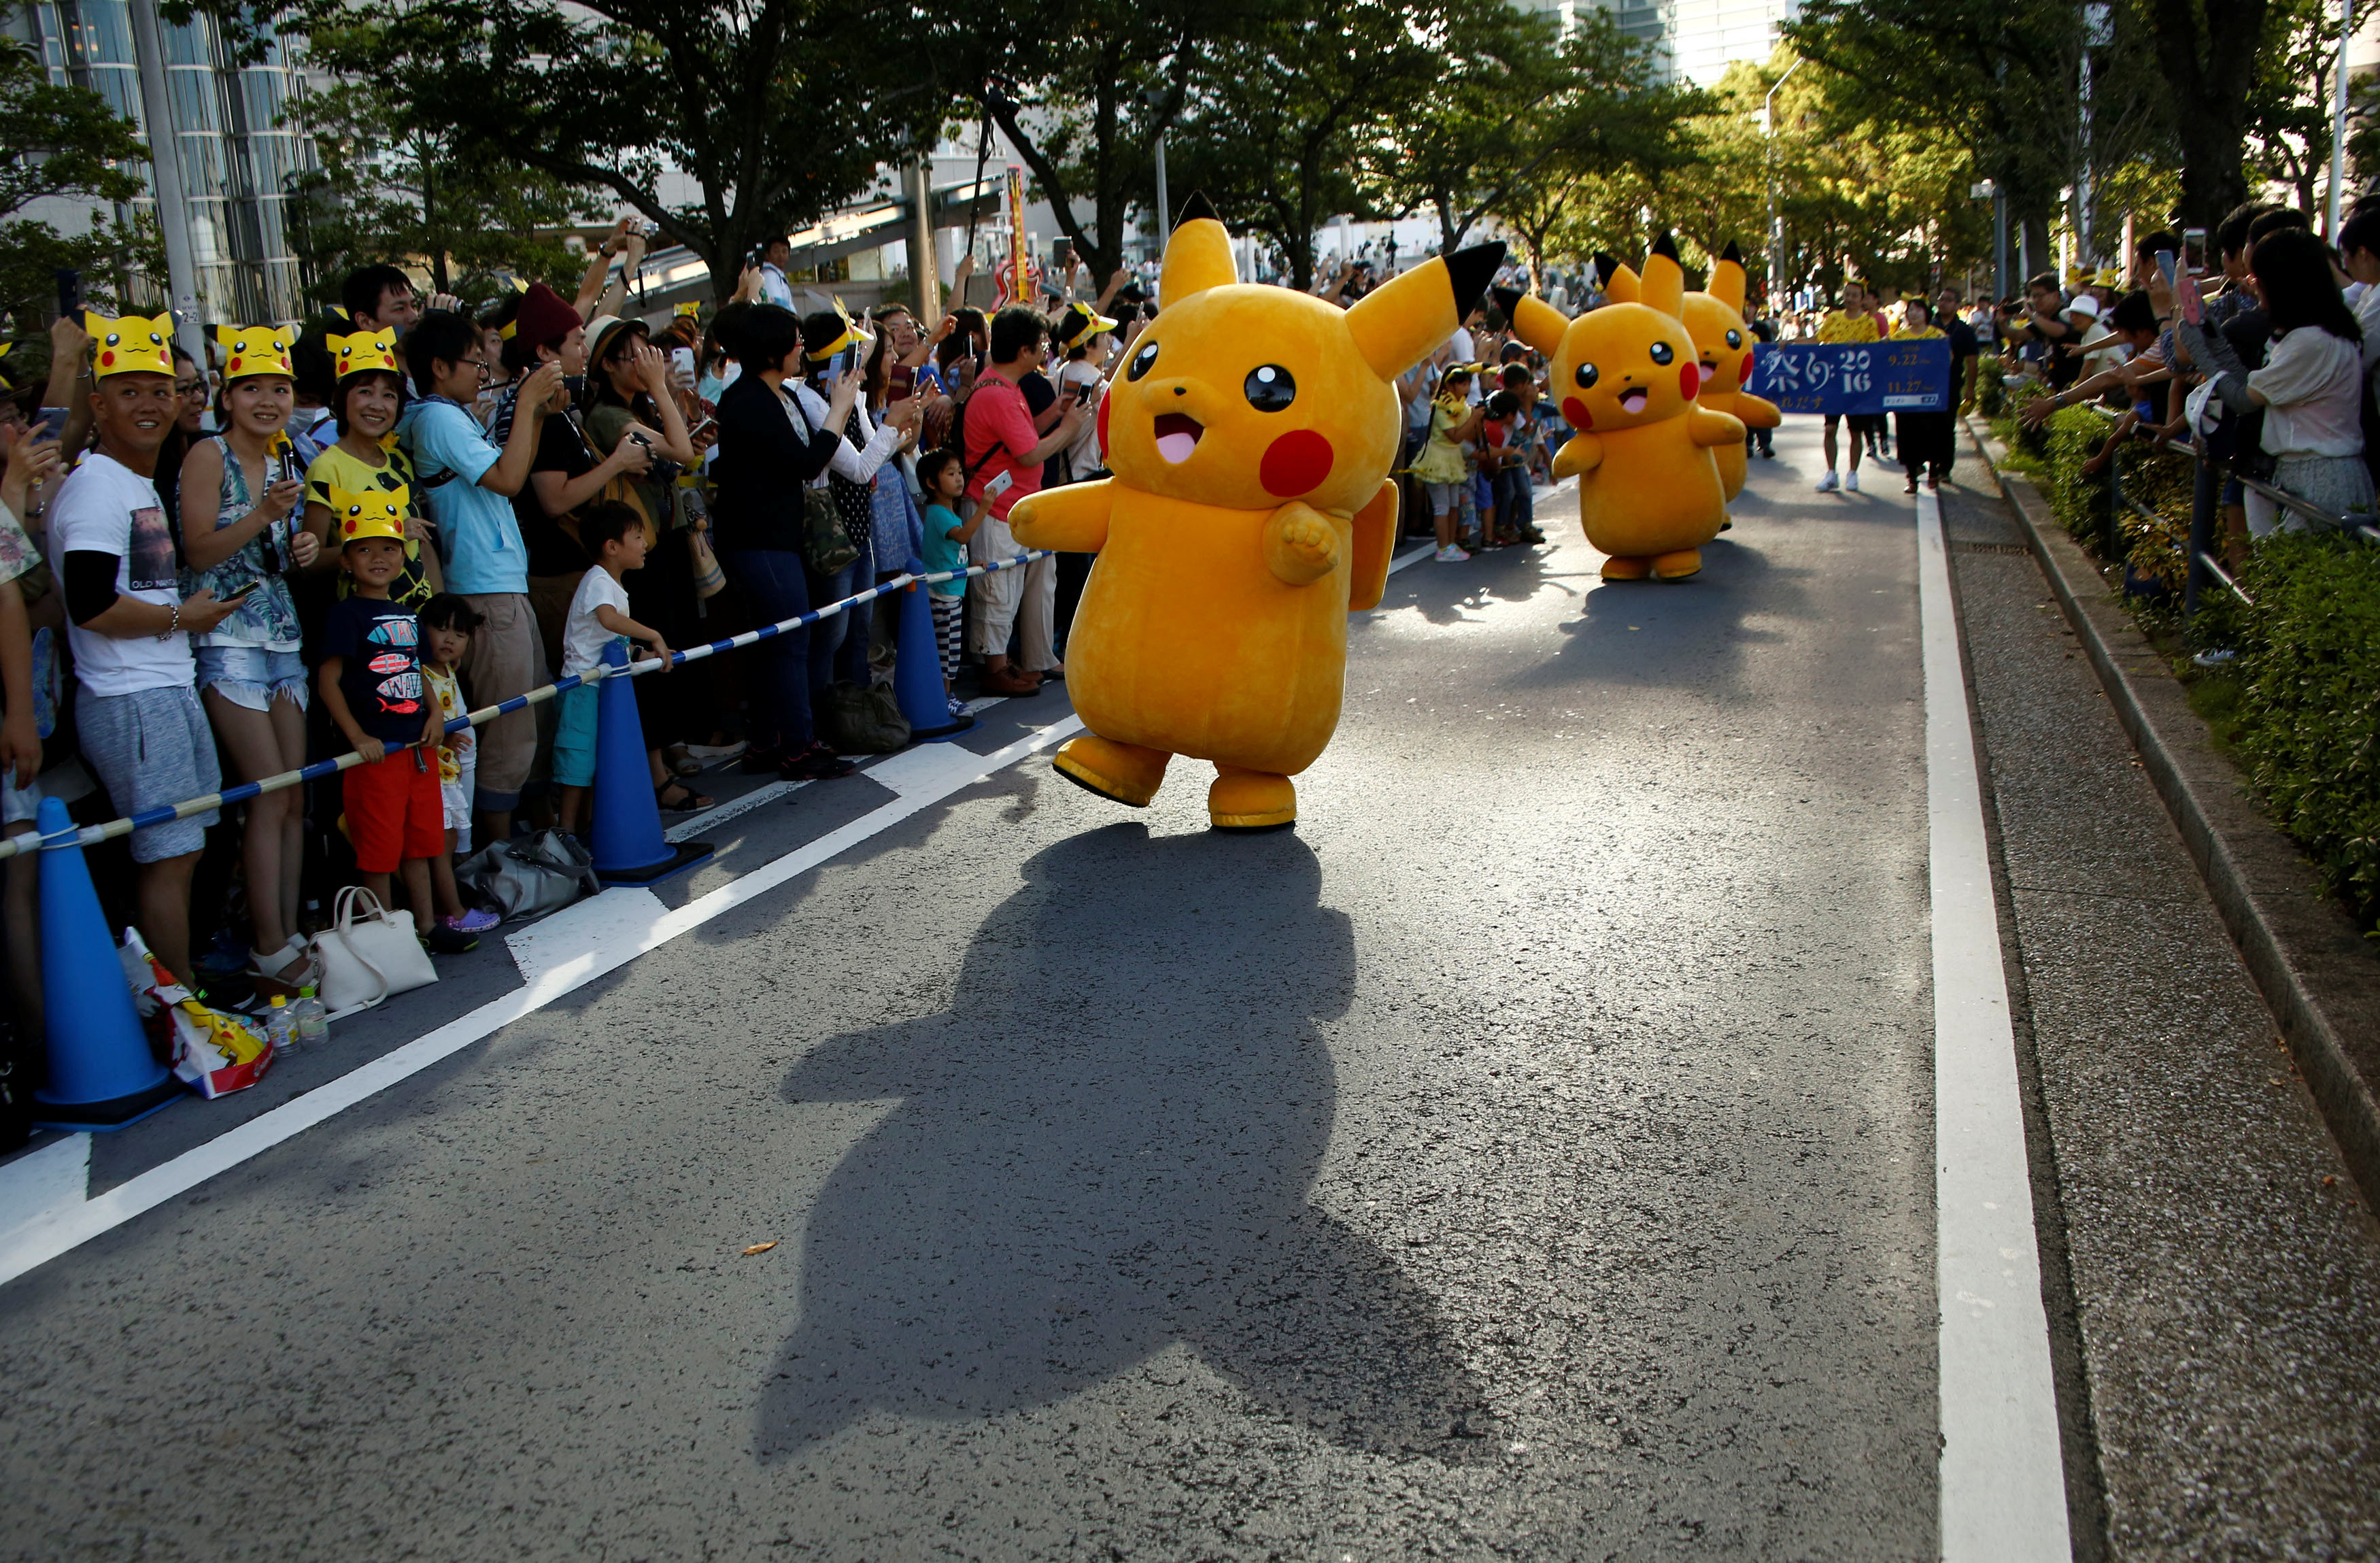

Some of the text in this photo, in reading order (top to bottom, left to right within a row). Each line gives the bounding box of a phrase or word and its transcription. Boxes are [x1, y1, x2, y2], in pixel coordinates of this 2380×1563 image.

[1887, 353, 1918, 367] 9.22
[1745, 348, 1830, 392] 祭り
[1887, 380, 1923, 392] 11.27
[132, 580, 154, 589] OLD
